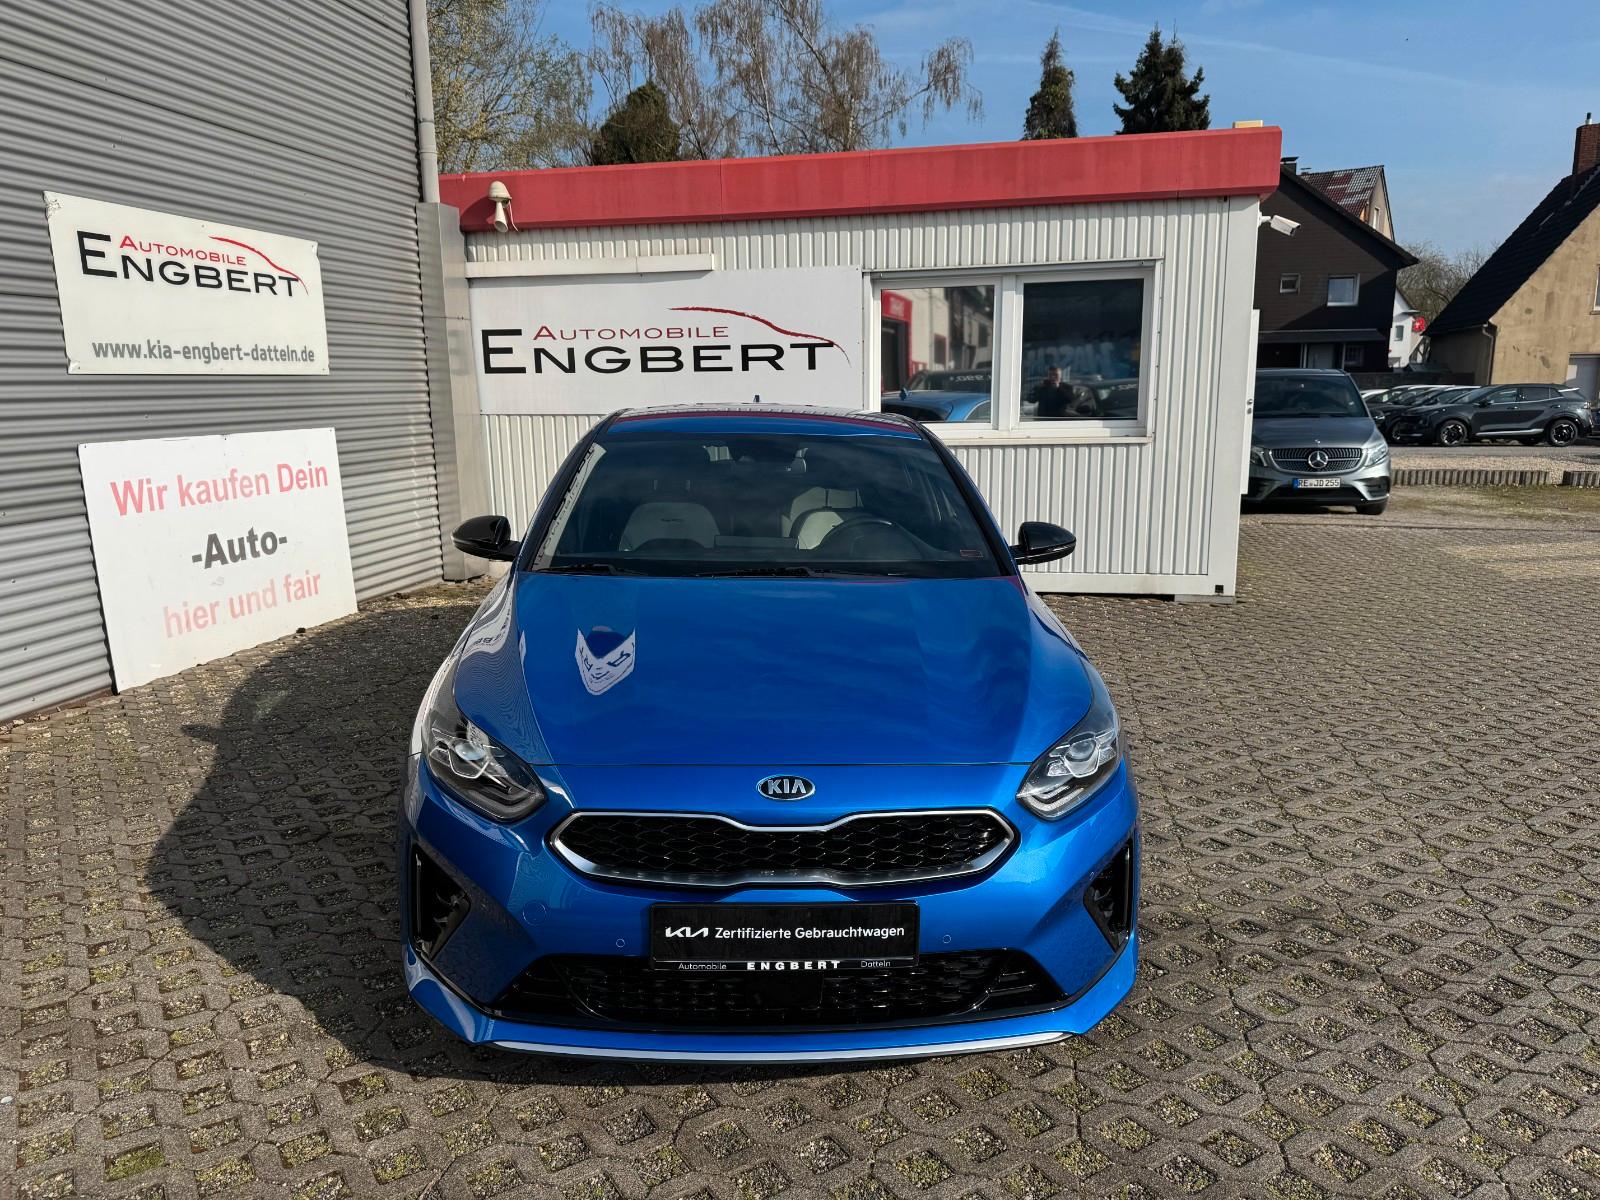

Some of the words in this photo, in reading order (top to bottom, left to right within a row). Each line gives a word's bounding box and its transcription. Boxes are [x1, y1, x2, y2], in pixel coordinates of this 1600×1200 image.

[76, 230, 300, 297] ENGBERT
[119, 234, 247, 266] AUTOMOBILE
[532, 325, 729, 341] AUTOMOBILE
[92, 339, 315, 364] www.kia-engbert-datteln.de
[480, 328, 834, 375] ENGBERT
[110, 478, 168, 516] Wir
[176, 468, 270, 507] kaufen
[276, 461, 329, 493] Dein
[1325, 479, 1340, 487] 255
[191, 527, 288, 569] -Auto-
[163, 600, 220, 638] hier
[229, 578, 278, 619] und
[283, 570, 321, 603] fair
[767, 778, 807, 794] KIA
[715, 927, 792, 939] Zertifizierte
[795, 926, 905, 940] Gebrauchtwagen
[747, 961, 840, 970] ENGBERT
[861, 960, 891, 968] Datteln
